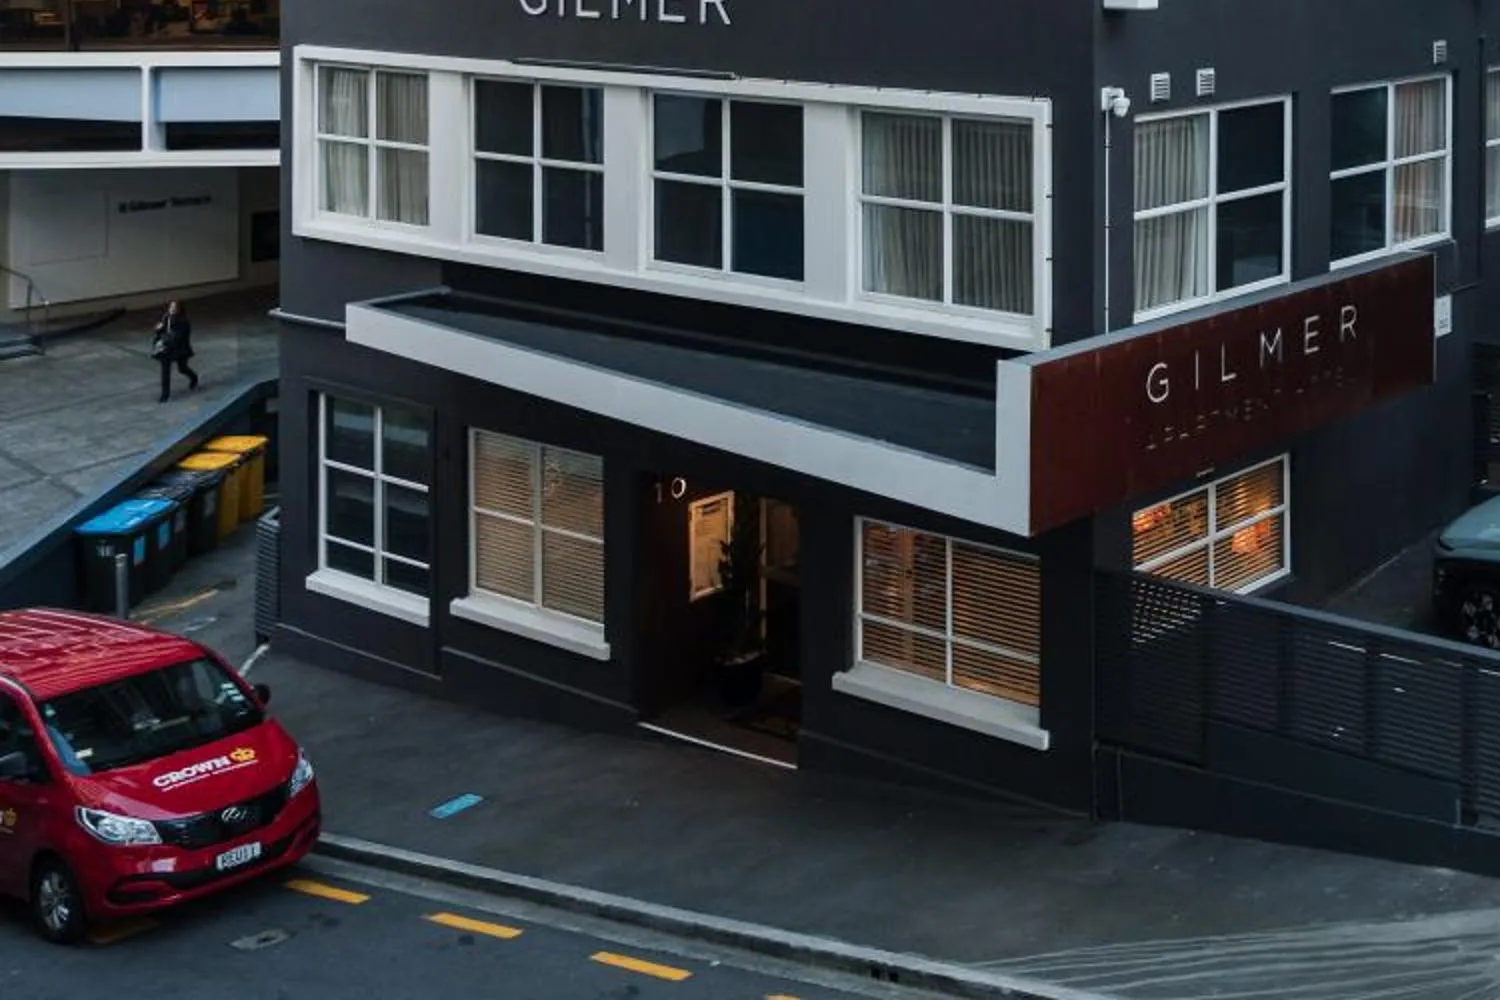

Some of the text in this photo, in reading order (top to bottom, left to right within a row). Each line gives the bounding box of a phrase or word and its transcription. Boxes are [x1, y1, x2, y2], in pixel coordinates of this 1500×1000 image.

[1146, 304, 1359, 404] GILMER
[654, 477, 687, 505] 10
[152, 755, 231, 787] CROWN
